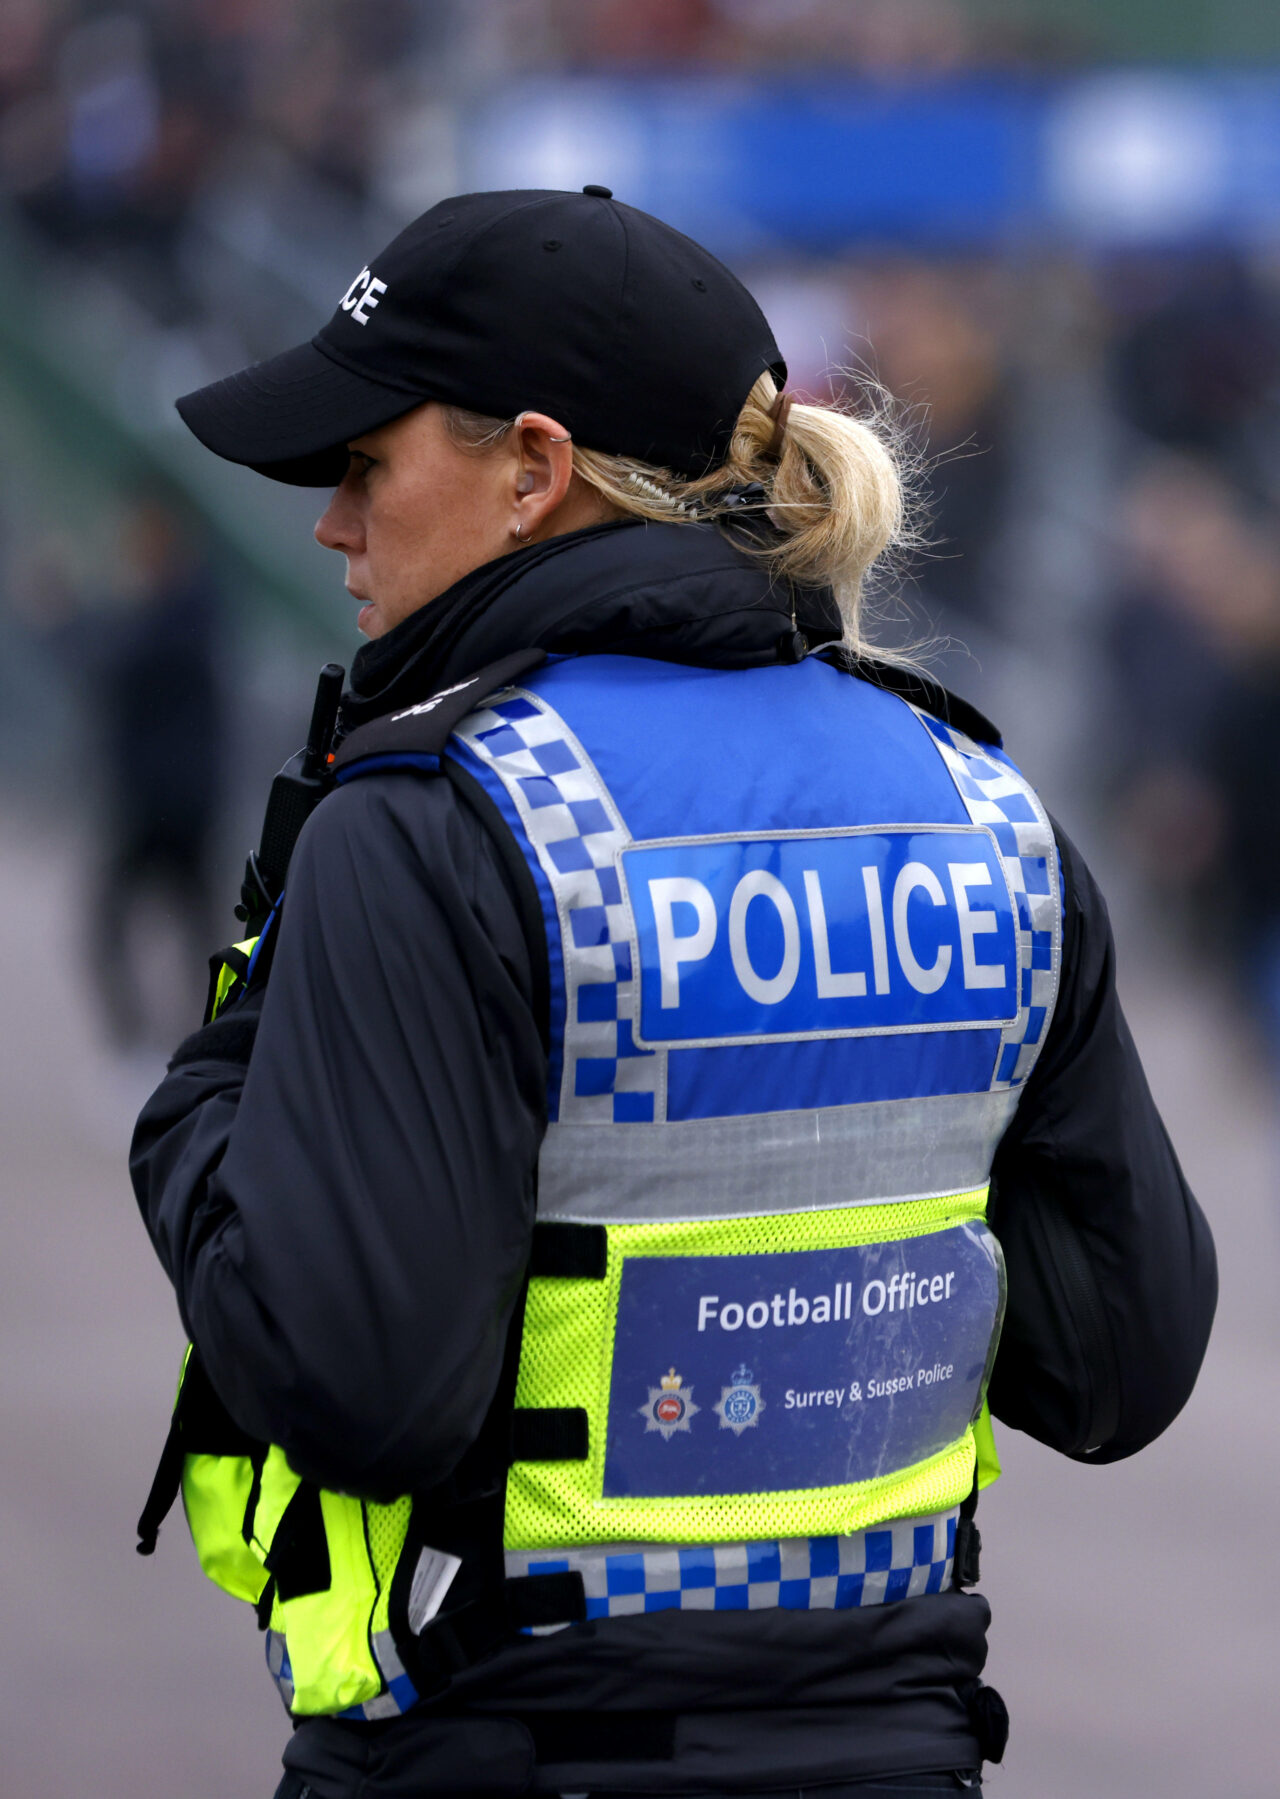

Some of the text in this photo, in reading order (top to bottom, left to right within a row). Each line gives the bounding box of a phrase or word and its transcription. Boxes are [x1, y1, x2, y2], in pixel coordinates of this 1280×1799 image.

[648, 861, 1007, 1010] POLICE
[697, 1271, 955, 1332] Football Officer
[784, 1362, 954, 1409] Surrey & Sussex Police
